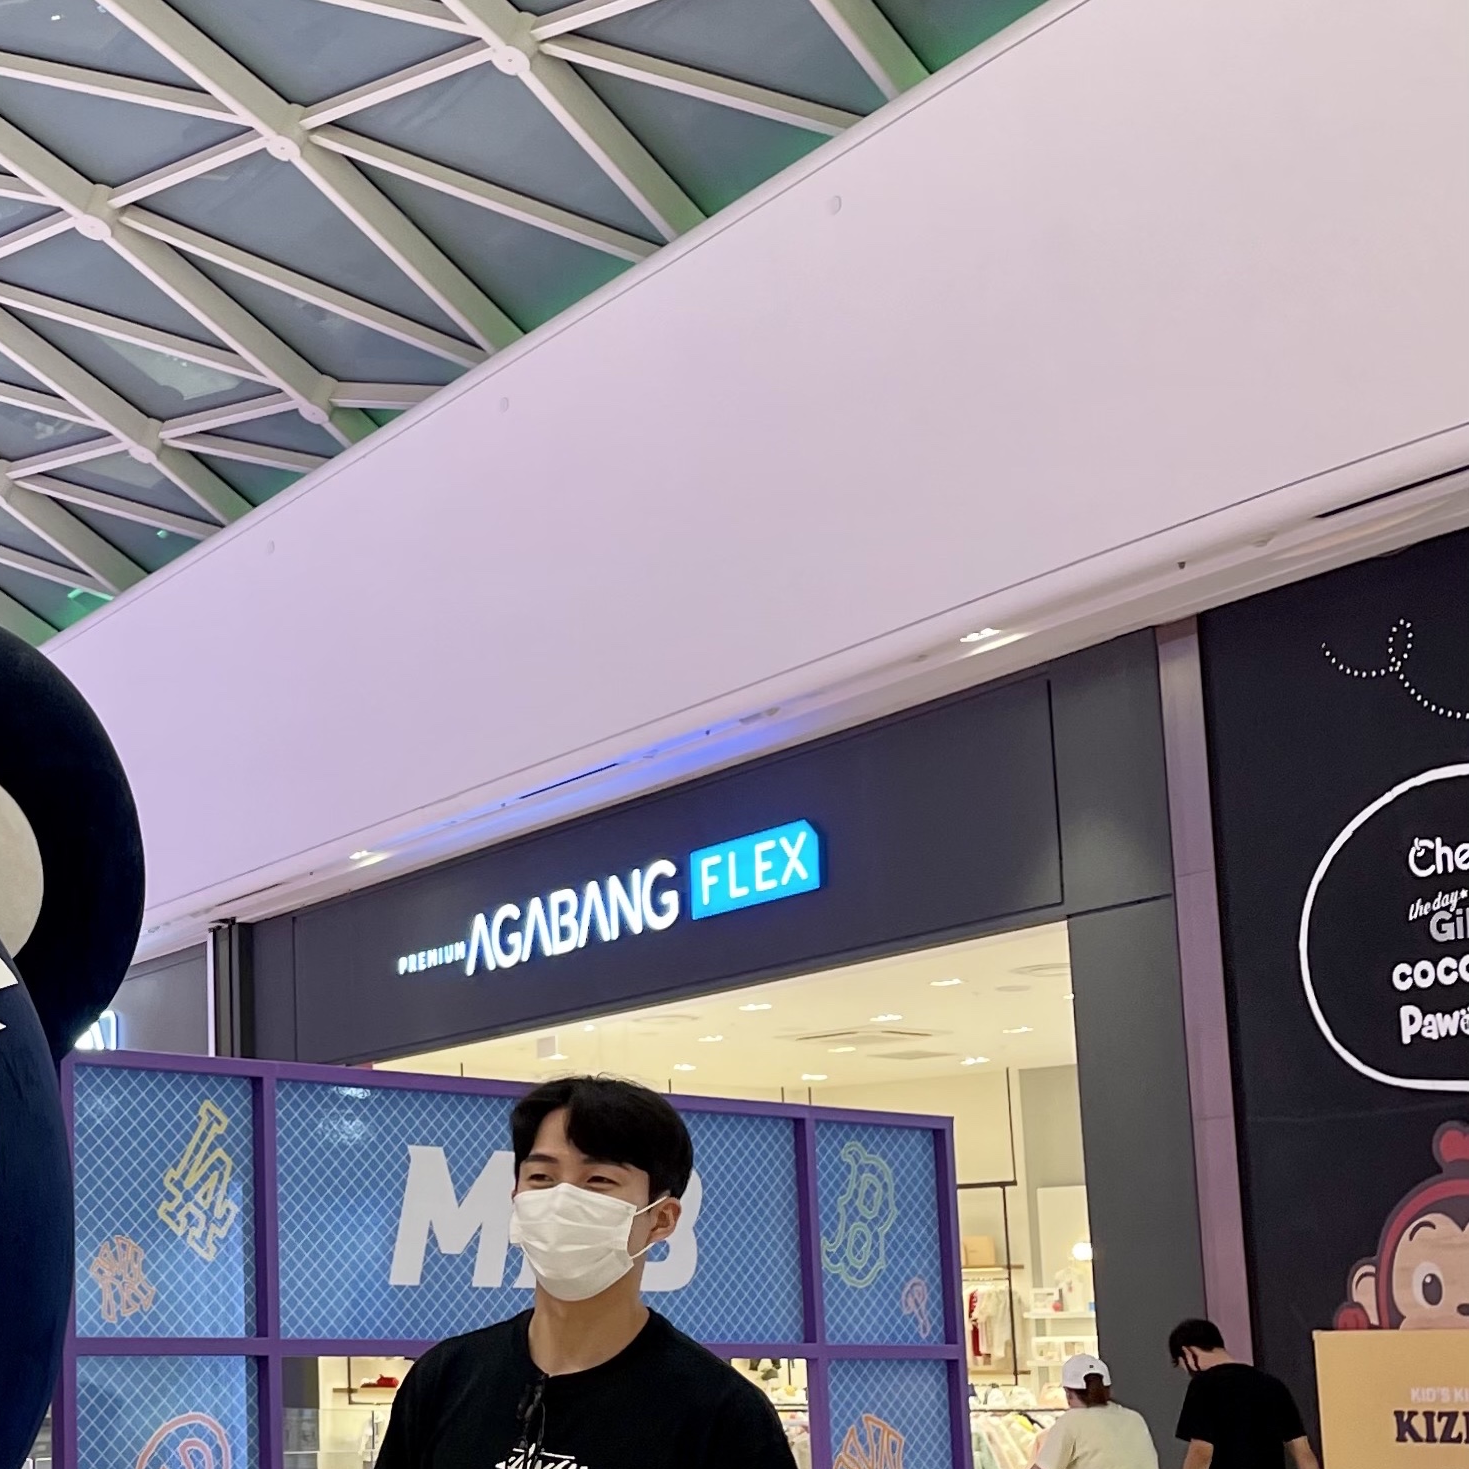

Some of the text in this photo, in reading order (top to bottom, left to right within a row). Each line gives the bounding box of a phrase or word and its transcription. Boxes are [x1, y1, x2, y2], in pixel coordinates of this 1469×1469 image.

[398, 830, 809, 976] PREMIUM AGABANG FLEX
